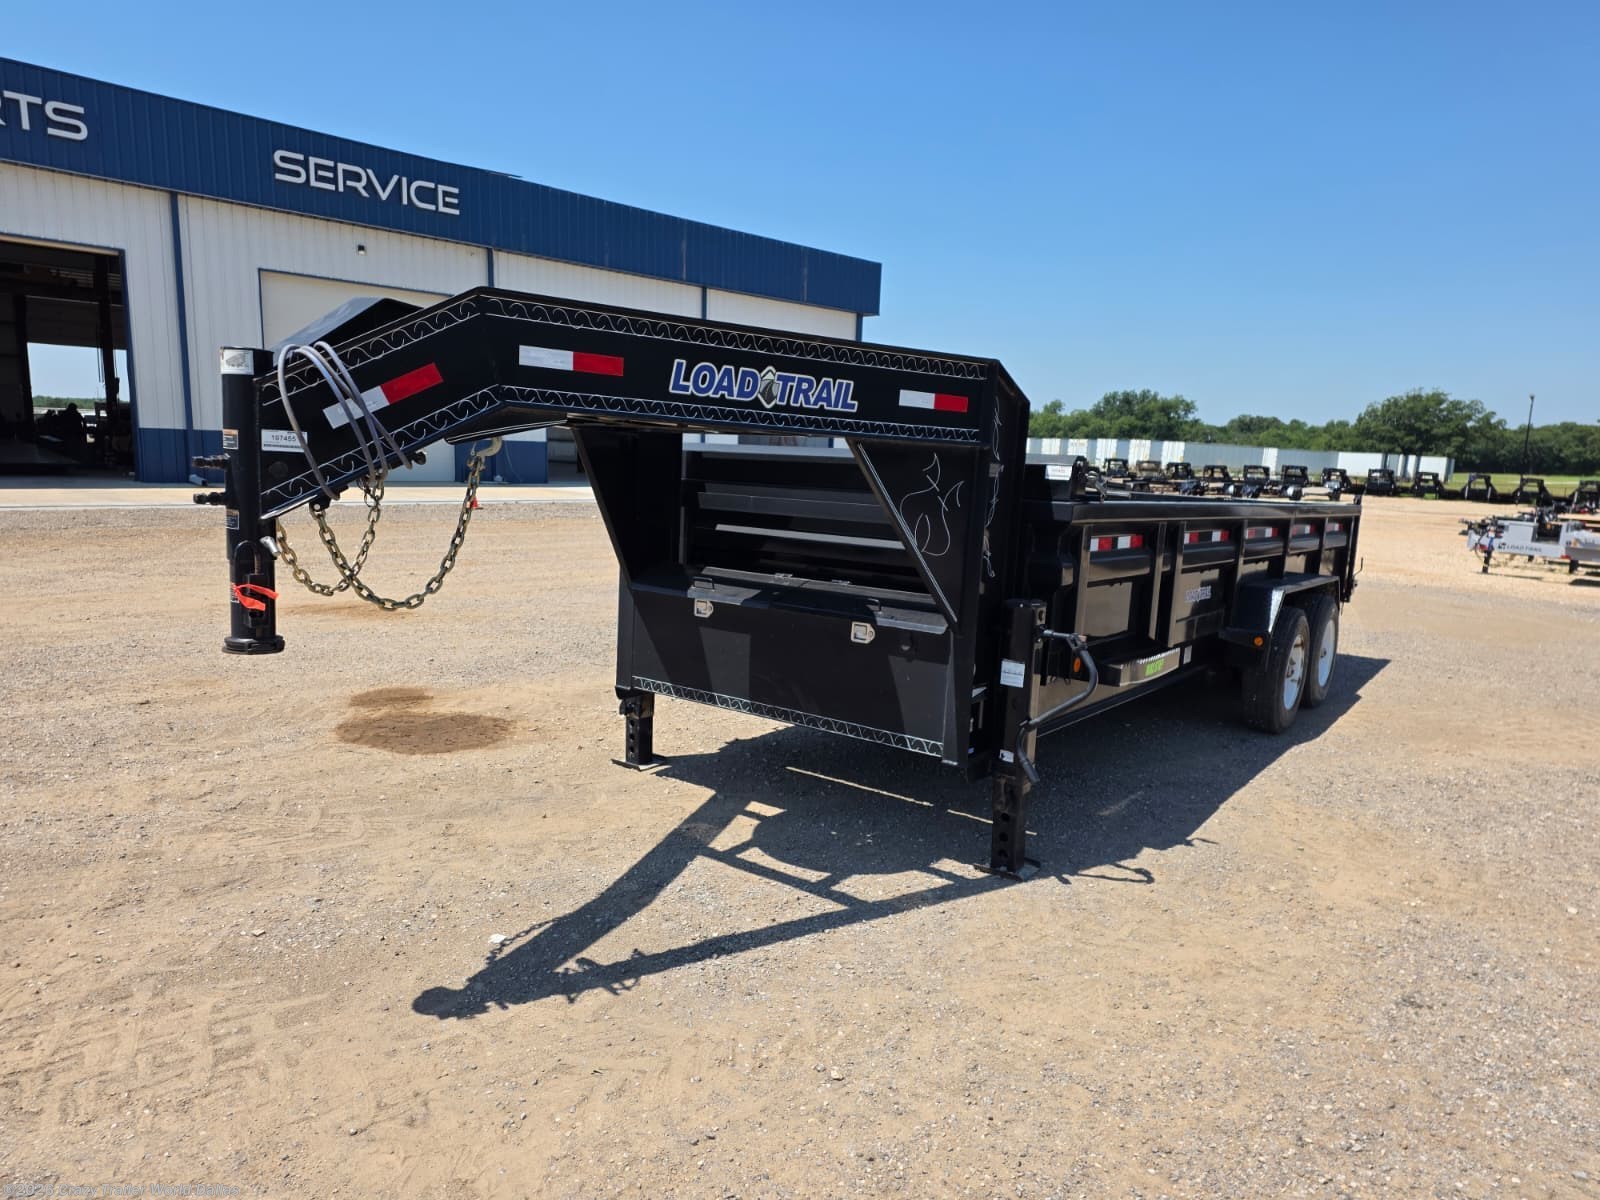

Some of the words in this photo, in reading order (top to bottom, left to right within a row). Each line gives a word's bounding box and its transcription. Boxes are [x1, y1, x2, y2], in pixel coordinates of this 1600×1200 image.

[273, 149, 460, 216] SERVICE
[669, 359, 761, 401] LOAD
[774, 371, 859, 413] TRAIL
